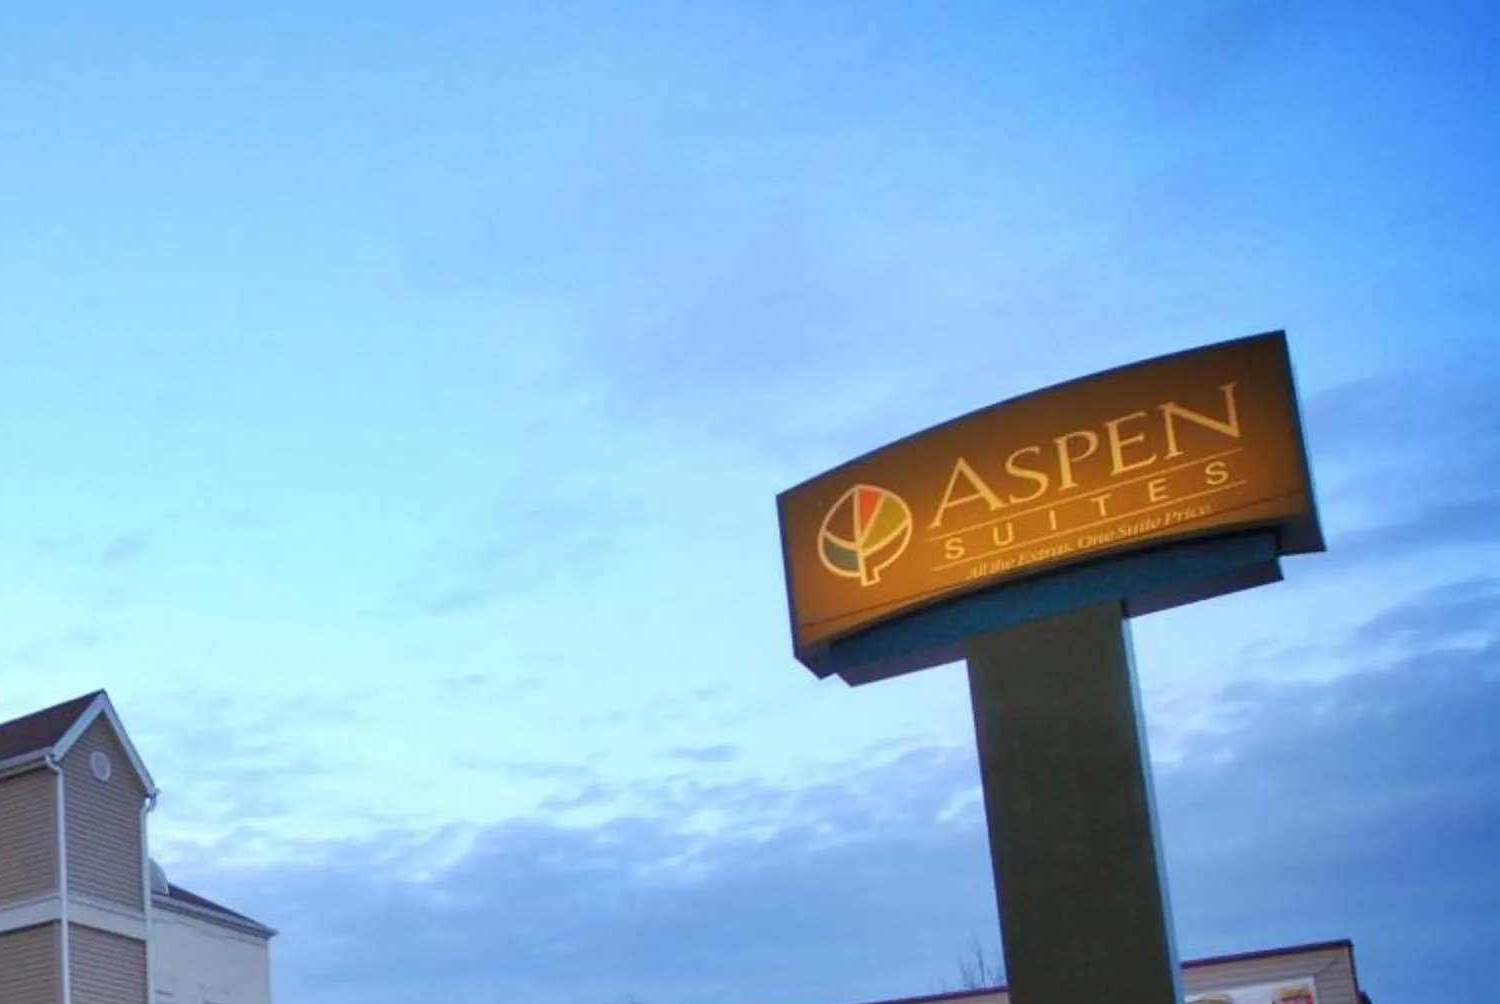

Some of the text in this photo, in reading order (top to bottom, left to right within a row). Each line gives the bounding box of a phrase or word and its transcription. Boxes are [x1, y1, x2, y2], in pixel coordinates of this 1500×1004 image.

[929, 381, 1241, 529] ASPEN
[945, 461, 1230, 560] SUITES
[965, 563, 987, 580] All
[1077, 531, 1115, 549] One
